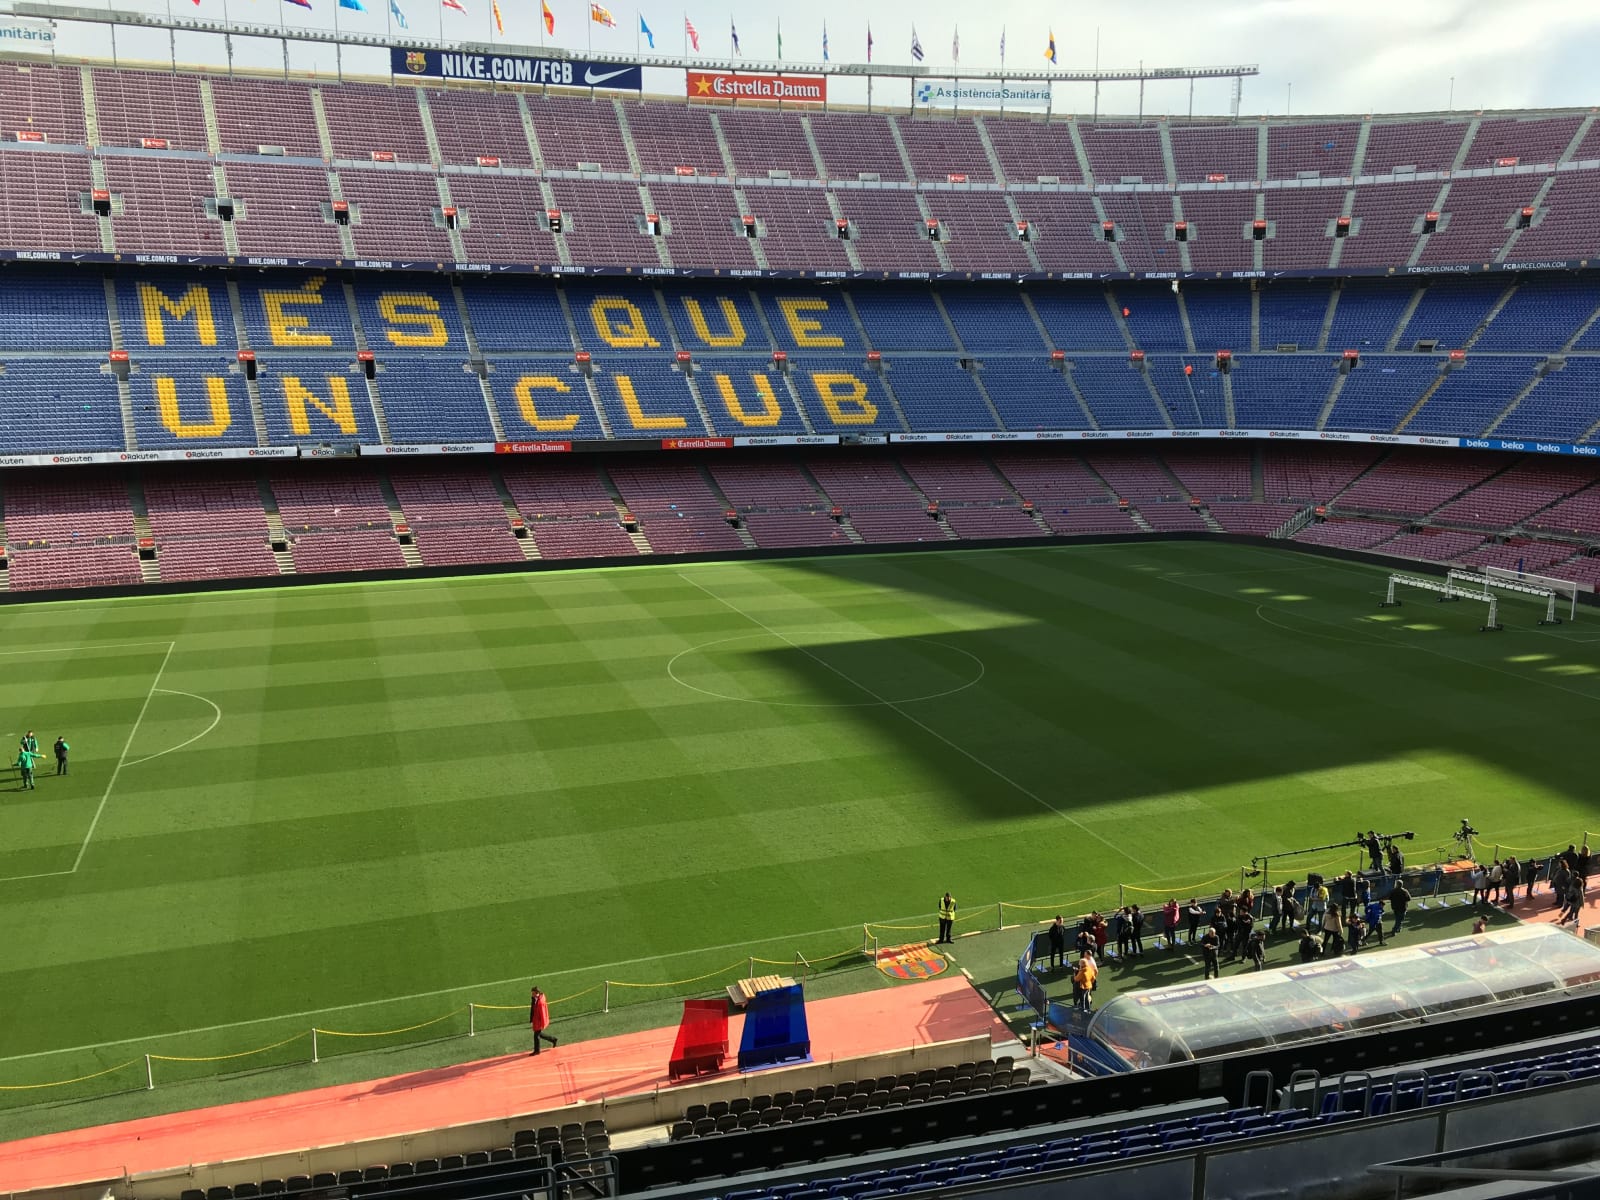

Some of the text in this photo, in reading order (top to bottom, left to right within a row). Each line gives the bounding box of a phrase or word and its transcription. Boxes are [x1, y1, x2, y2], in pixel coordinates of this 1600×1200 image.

[0, 27, 52, 41] nitària
[441, 54, 573, 84] NIKE.COM/FCB
[713, 77, 820, 98] Estrella Damm
[936, 87, 1051, 100] Assistència Sanitària
[16, 252, 60, 260] NIKE.COM/FCB
[136, 254, 178, 263] NIKE.COM/FCB
[249, 257, 288, 266] NIKE.COM/FCB
[355, 260, 392, 268] NIKE.COM/FCB
[1503, 261, 1567, 270] FCBARCELONA.COM
[456, 263, 491, 271] NIKE.COM/FCB
[1408, 265, 1469, 273] FCBARCELONA.COM
[137, 276, 845, 348] MÉS QUE
[152, 372, 879, 438] UN CLUB
[512, 443, 564, 452] Estrella Damm
[678, 440, 726, 448] Estrella Damm
[1467, 439, 1489, 448] beko
[1502, 441, 1524, 450] beko
[255, 448, 284, 456] Rakuten
[318, 448, 335, 456] Raku
[1537, 444, 1560, 453] beko
[1573, 446, 1596, 455] beko
[60, 454, 92, 463] Rakuten
[127, 452, 159, 460] Rakuten
[192, 450, 222, 458] Rakuten
